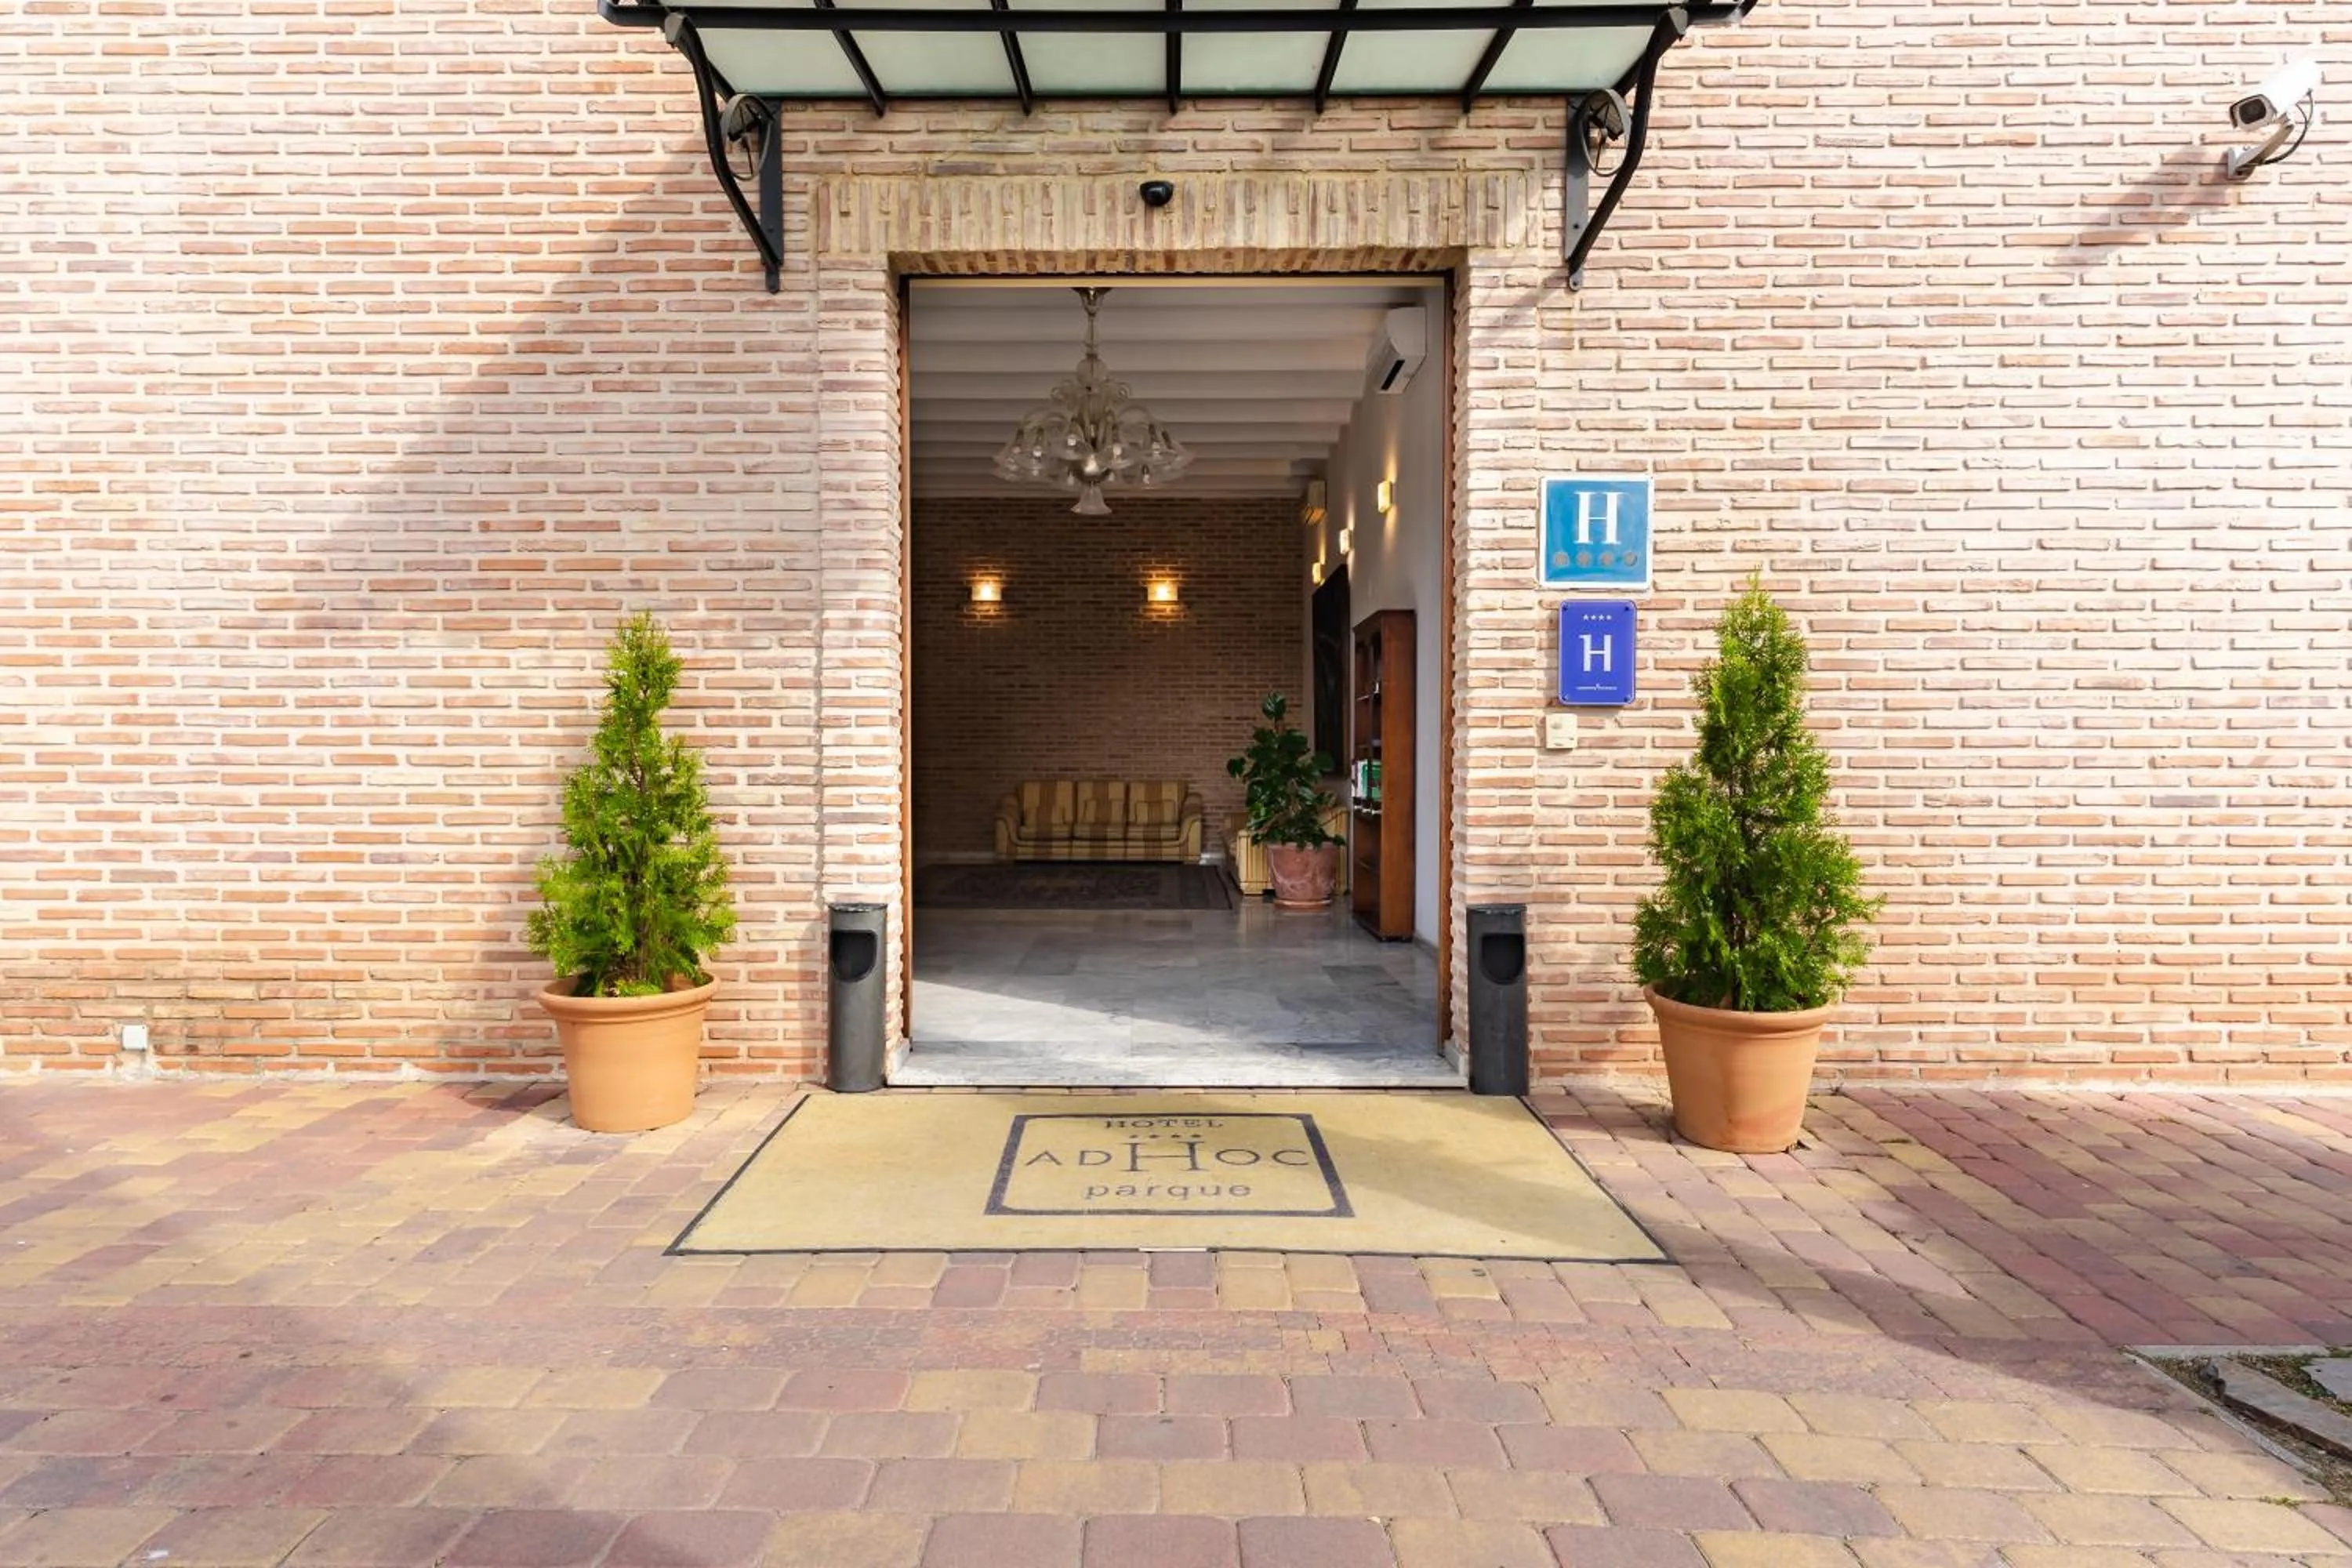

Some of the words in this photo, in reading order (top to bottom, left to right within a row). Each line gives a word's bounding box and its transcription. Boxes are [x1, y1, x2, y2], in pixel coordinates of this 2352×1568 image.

[1573, 491, 1626, 544] H
[1579, 634, 1612, 672] H
[1105, 1118, 1224, 1128] HOTEL
[1085, 1182, 1251, 1200] parque
